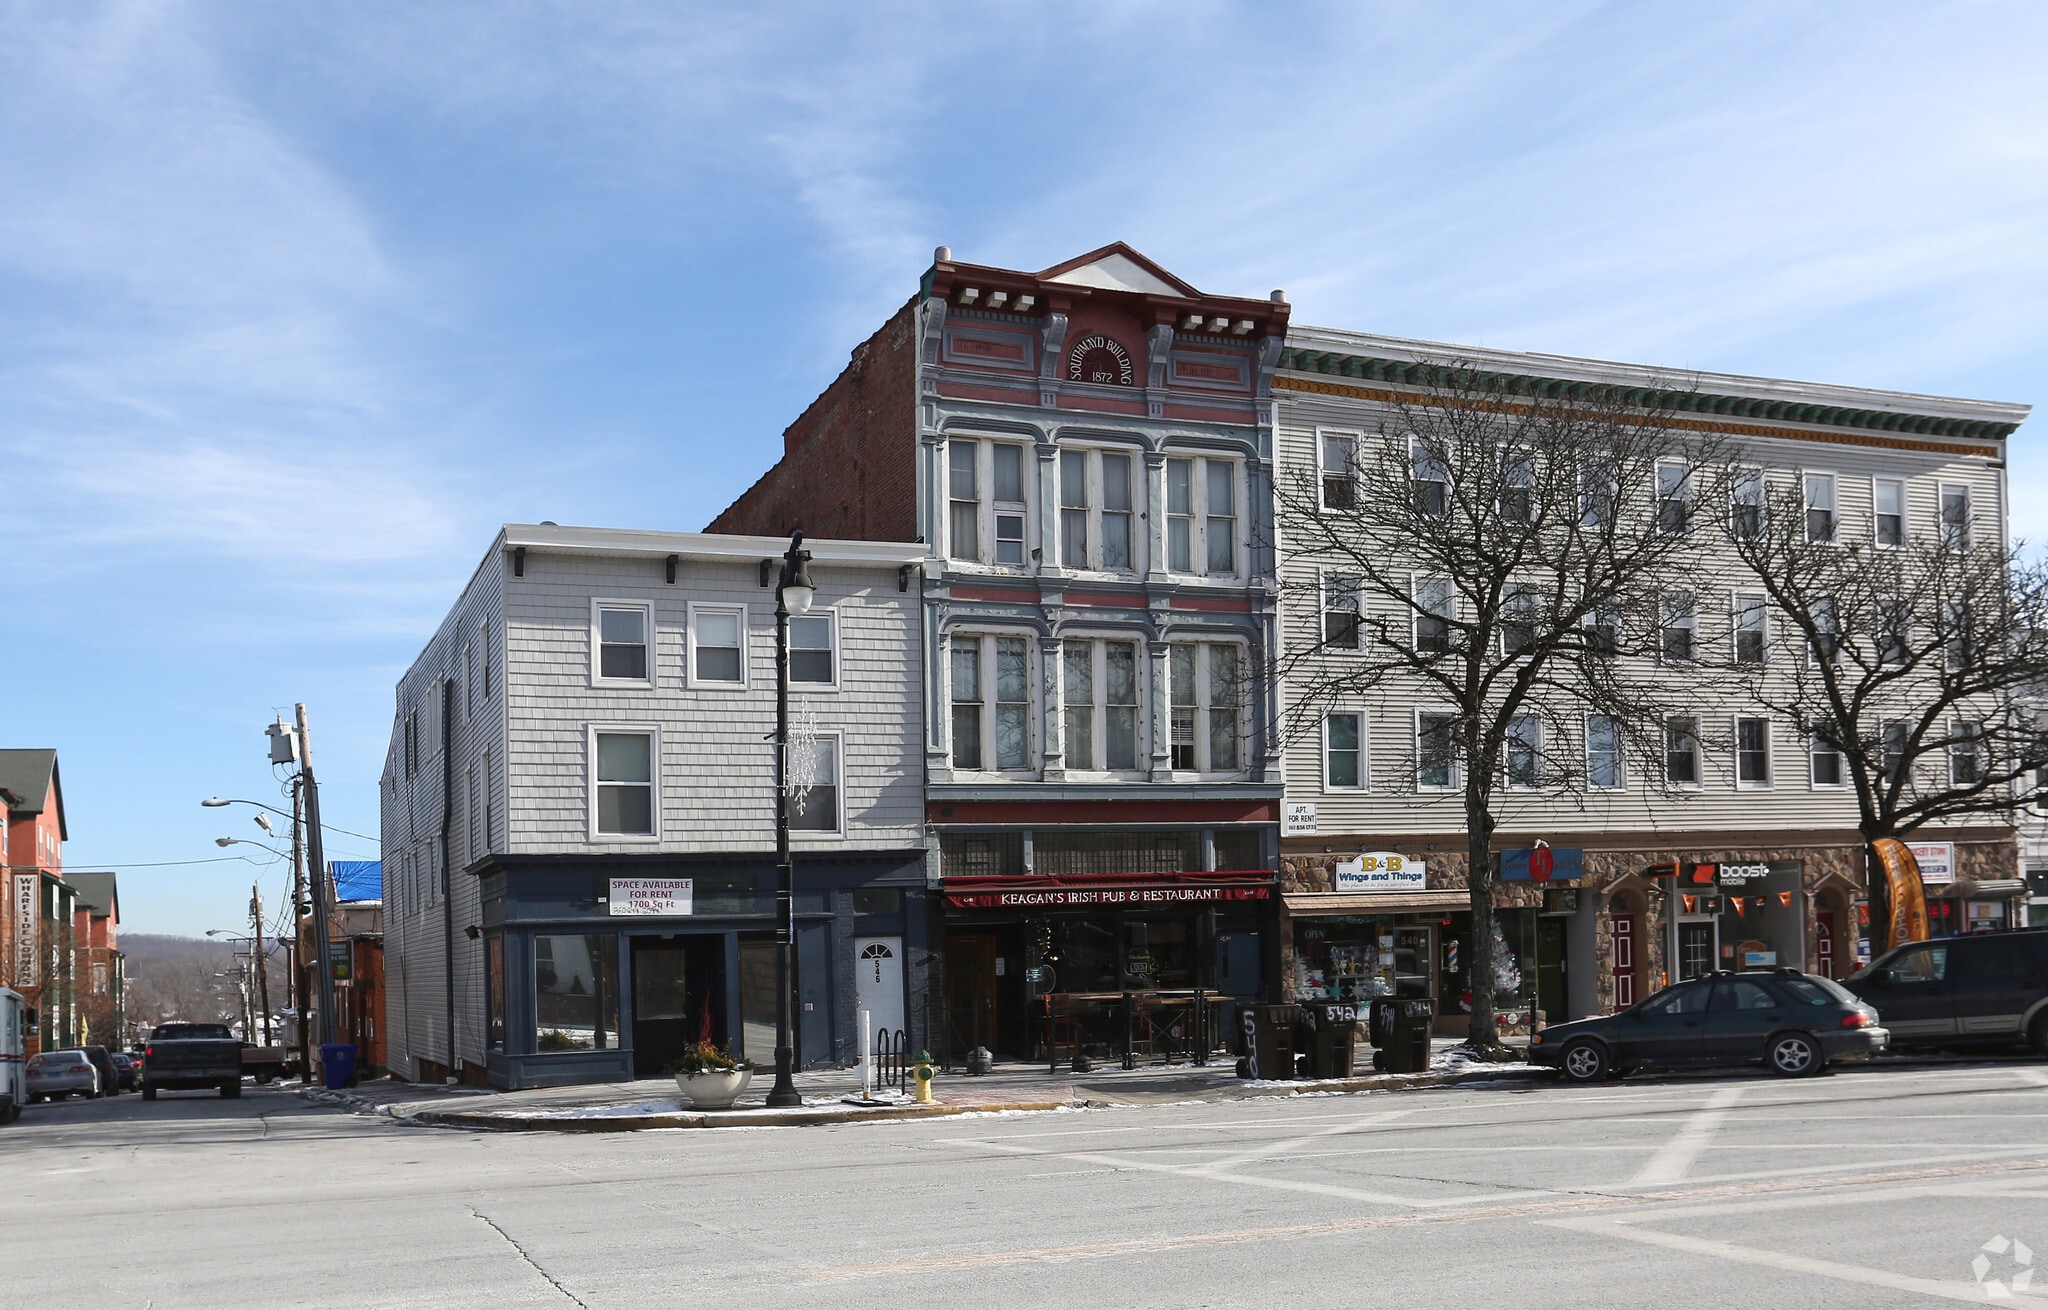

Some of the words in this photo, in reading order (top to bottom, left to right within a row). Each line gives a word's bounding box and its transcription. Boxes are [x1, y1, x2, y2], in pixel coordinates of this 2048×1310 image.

[1070, 337, 1104, 380] SOUTHMAYD
[1106, 340, 1132, 384] BUILDING
[1092, 371, 1113, 383] 1872
[1288, 814, 1300, 823] FOR
[1301, 814, 1315, 823] RENT
[1720, 863, 1768, 877] boost
[1339, 872, 1369, 883] Wings
[1371, 872, 1389, 881] and
[1390, 872, 1422, 882] Things
[1720, 878, 1746, 886] mobile
[612, 881, 640, 889] SPACE
[642, 881, 690, 889] AVAILABLE
[1001, 892, 1065, 905] KEAGAN'S
[1067, 891, 1099, 903] IRISH
[1102, 891, 1126, 902] PUB
[1129, 890, 1140, 901] &
[1143, 888, 1221, 901] RESTAURANT
[20, 877, 32, 936] WHARFSIDE
[628, 900, 650, 908] 1700
[652, 900, 663, 910] Sq
[666, 900, 675, 908] Ft
[1304, 929, 1326, 939] OPEN
[1401, 936, 1419, 945] 540
[20, 939, 32, 985] COMMONS
[1326, 1004, 1357, 1022] 542
[1243, 1011, 1259, 1079] 540
